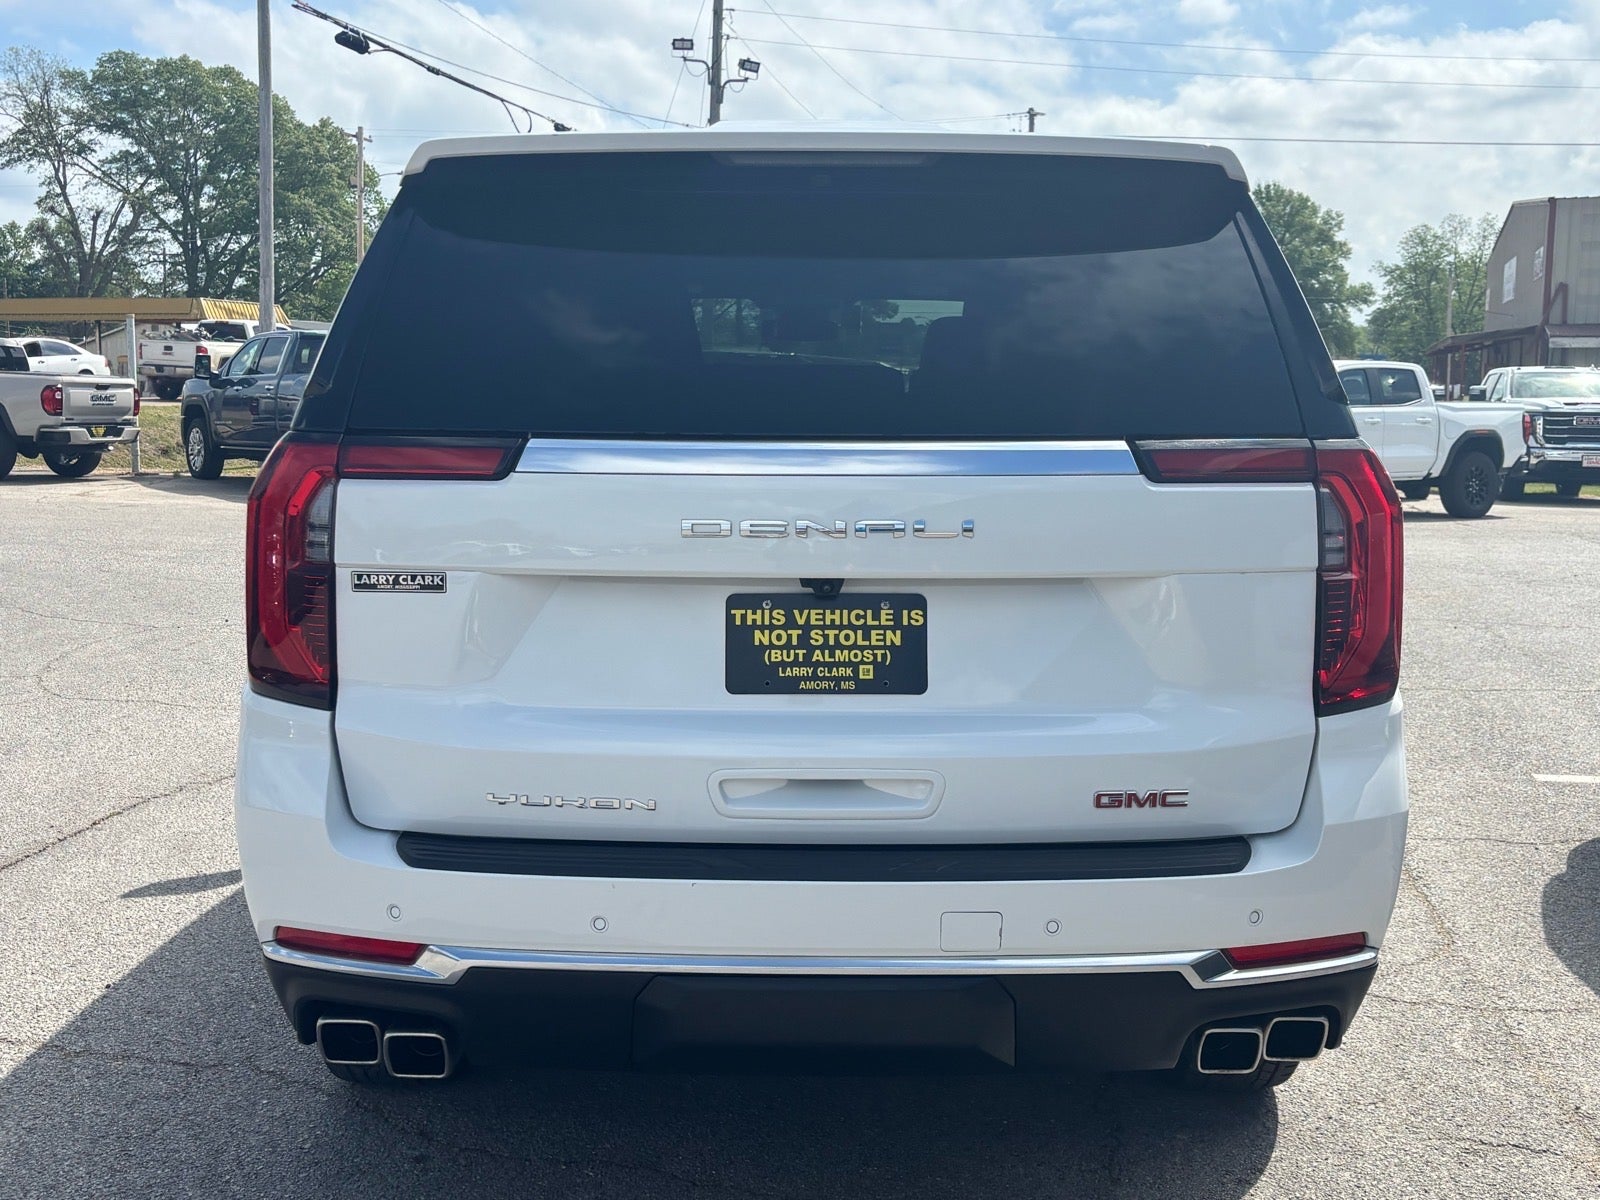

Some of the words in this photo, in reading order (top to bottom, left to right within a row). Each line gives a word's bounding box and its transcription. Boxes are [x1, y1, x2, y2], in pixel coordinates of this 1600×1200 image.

[680, 518, 975, 539] DENALI
[354, 574, 395, 585] LARRY
[399, 575, 443, 585] CLARK
[731, 609, 786, 626] THIS
[793, 609, 895, 626] VEHICLE
[902, 609, 925, 626] IS
[754, 629, 802, 646] NOT
[809, 629, 902, 646] STOLEN
[764, 650, 806, 665] (BUT
[812, 650, 891, 665] ALMOST)
[779, 667, 813, 677] LARRY
[817, 667, 853, 677] CLARK
[799, 681, 838, 690] AMORY,
[841, 681, 855, 690] MS
[486, 793, 656, 811] YUKON
[1094, 789, 1189, 808] GMC
